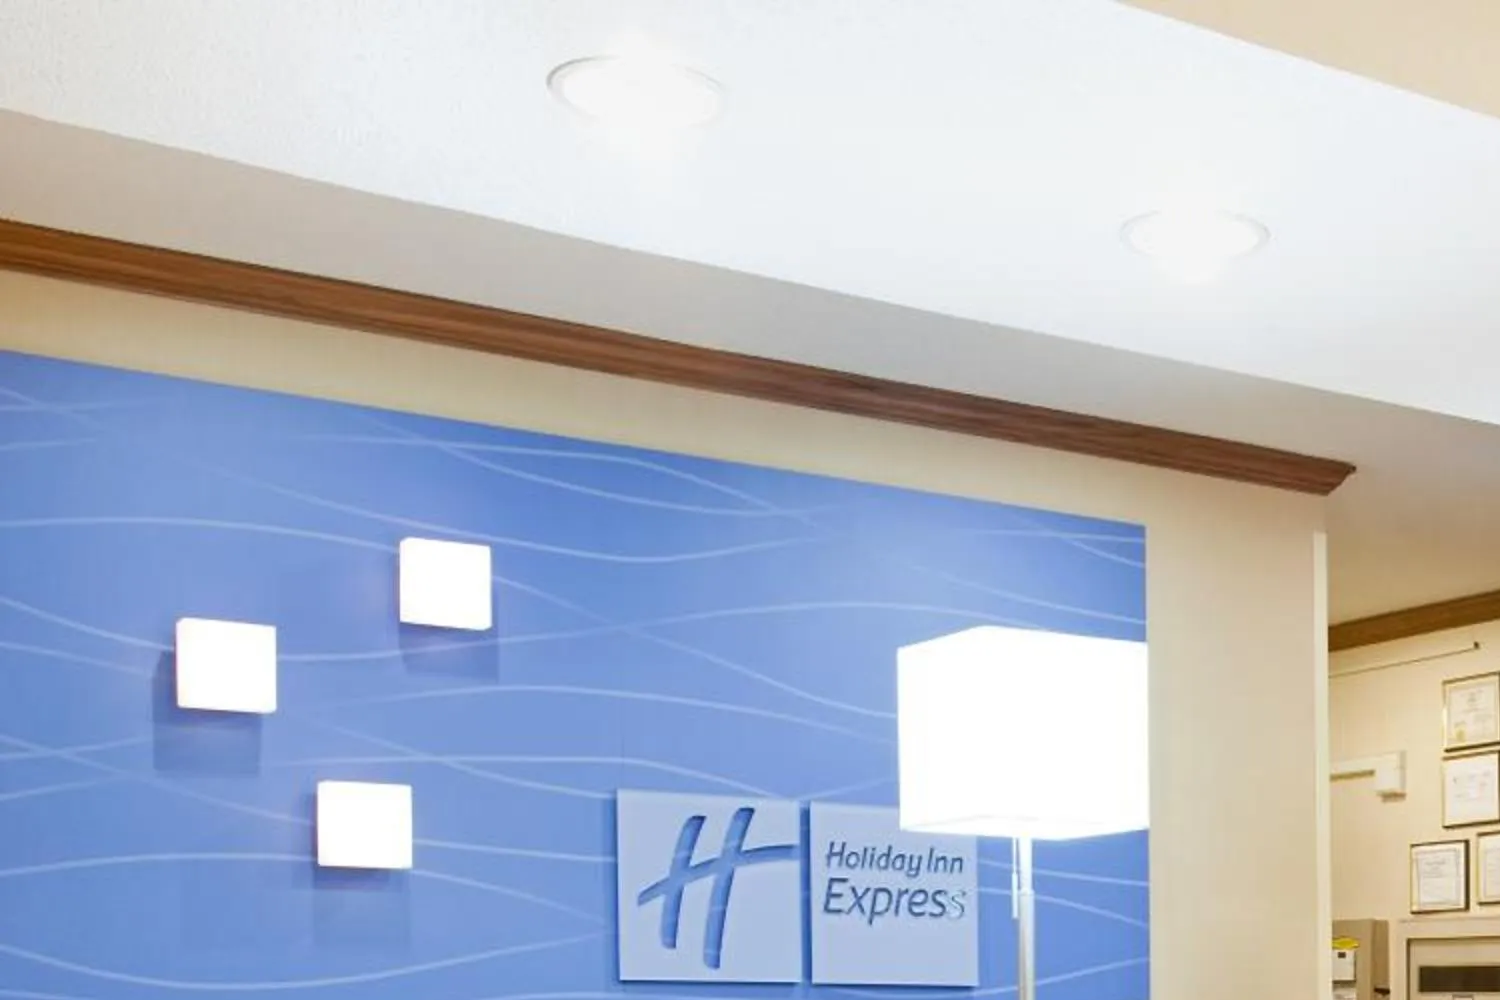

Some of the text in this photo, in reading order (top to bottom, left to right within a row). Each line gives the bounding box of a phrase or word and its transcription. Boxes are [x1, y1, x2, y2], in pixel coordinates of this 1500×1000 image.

[825, 841, 964, 878] Holiday Inn
[822, 876, 967, 926] Express
